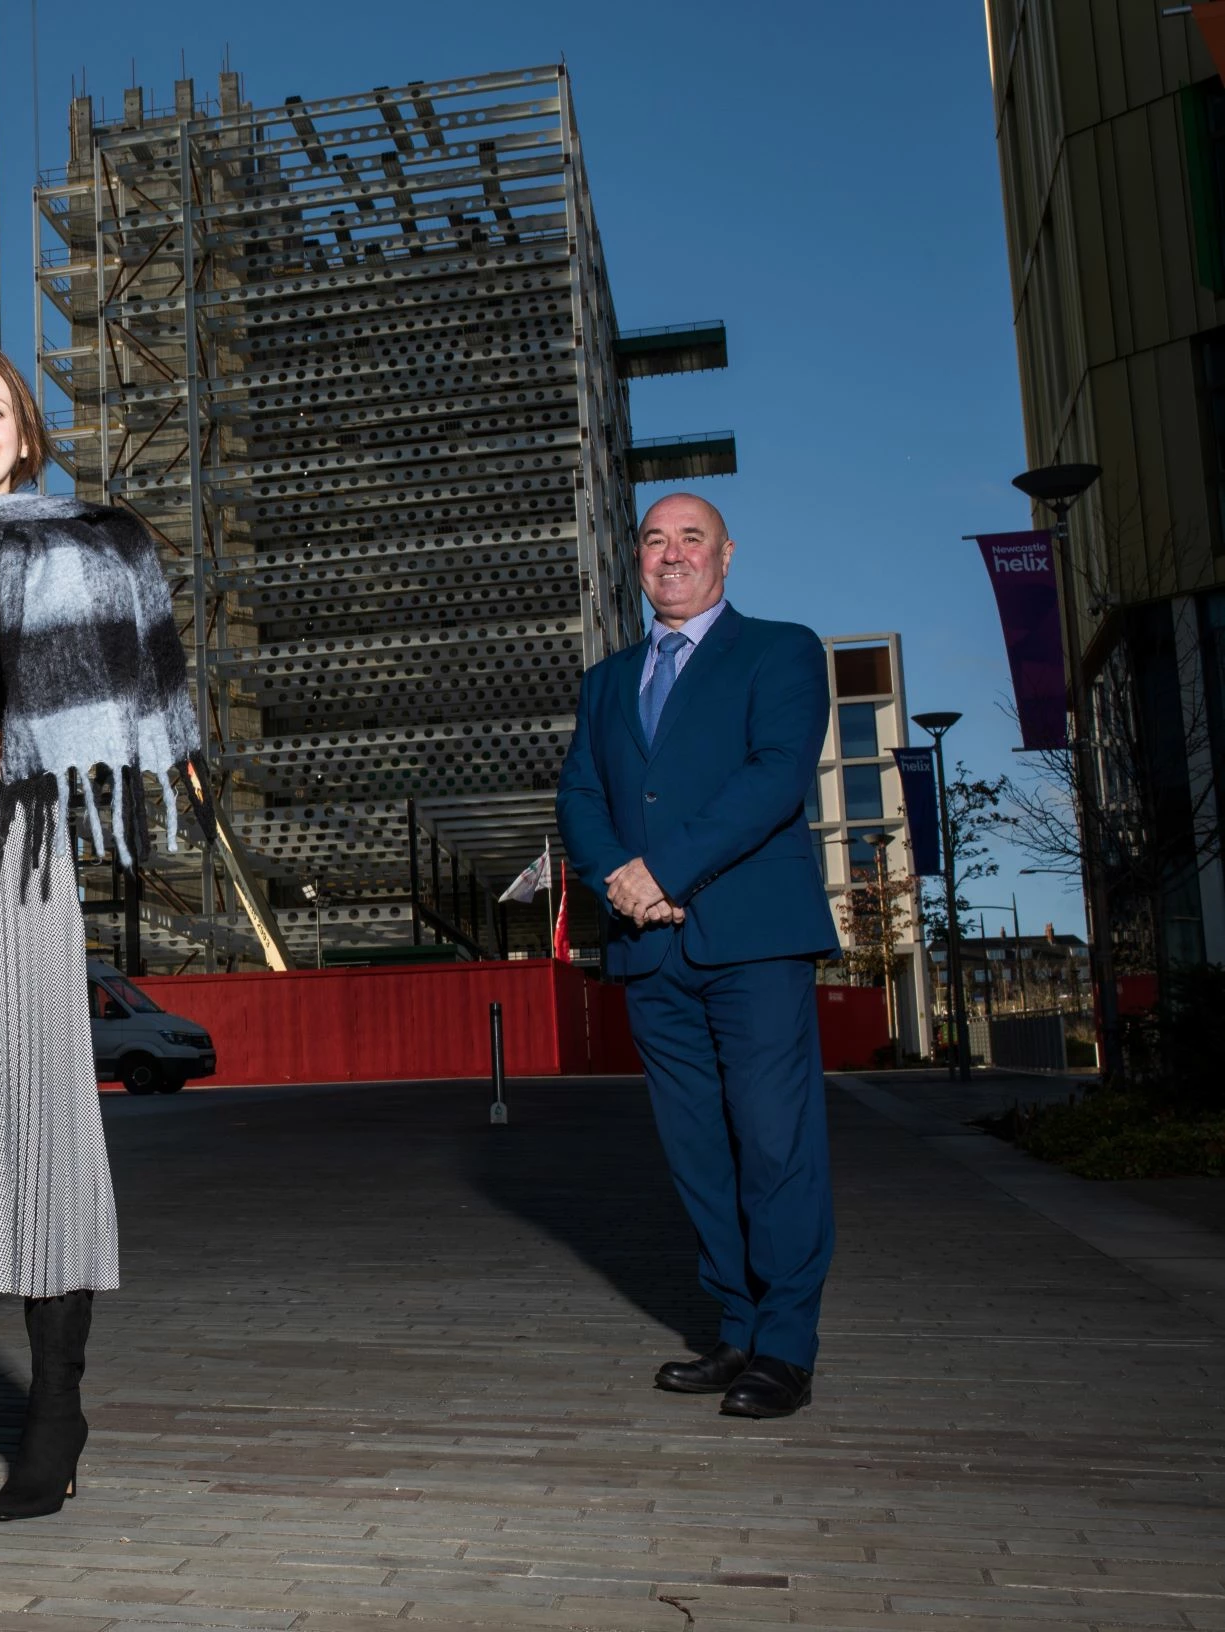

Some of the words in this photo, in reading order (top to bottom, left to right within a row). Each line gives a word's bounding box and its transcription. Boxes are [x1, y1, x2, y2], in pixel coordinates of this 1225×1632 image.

[992, 543, 1047, 554] Newcastle
[994, 554, 1049, 572] helix
[901, 760, 931, 771] helix
